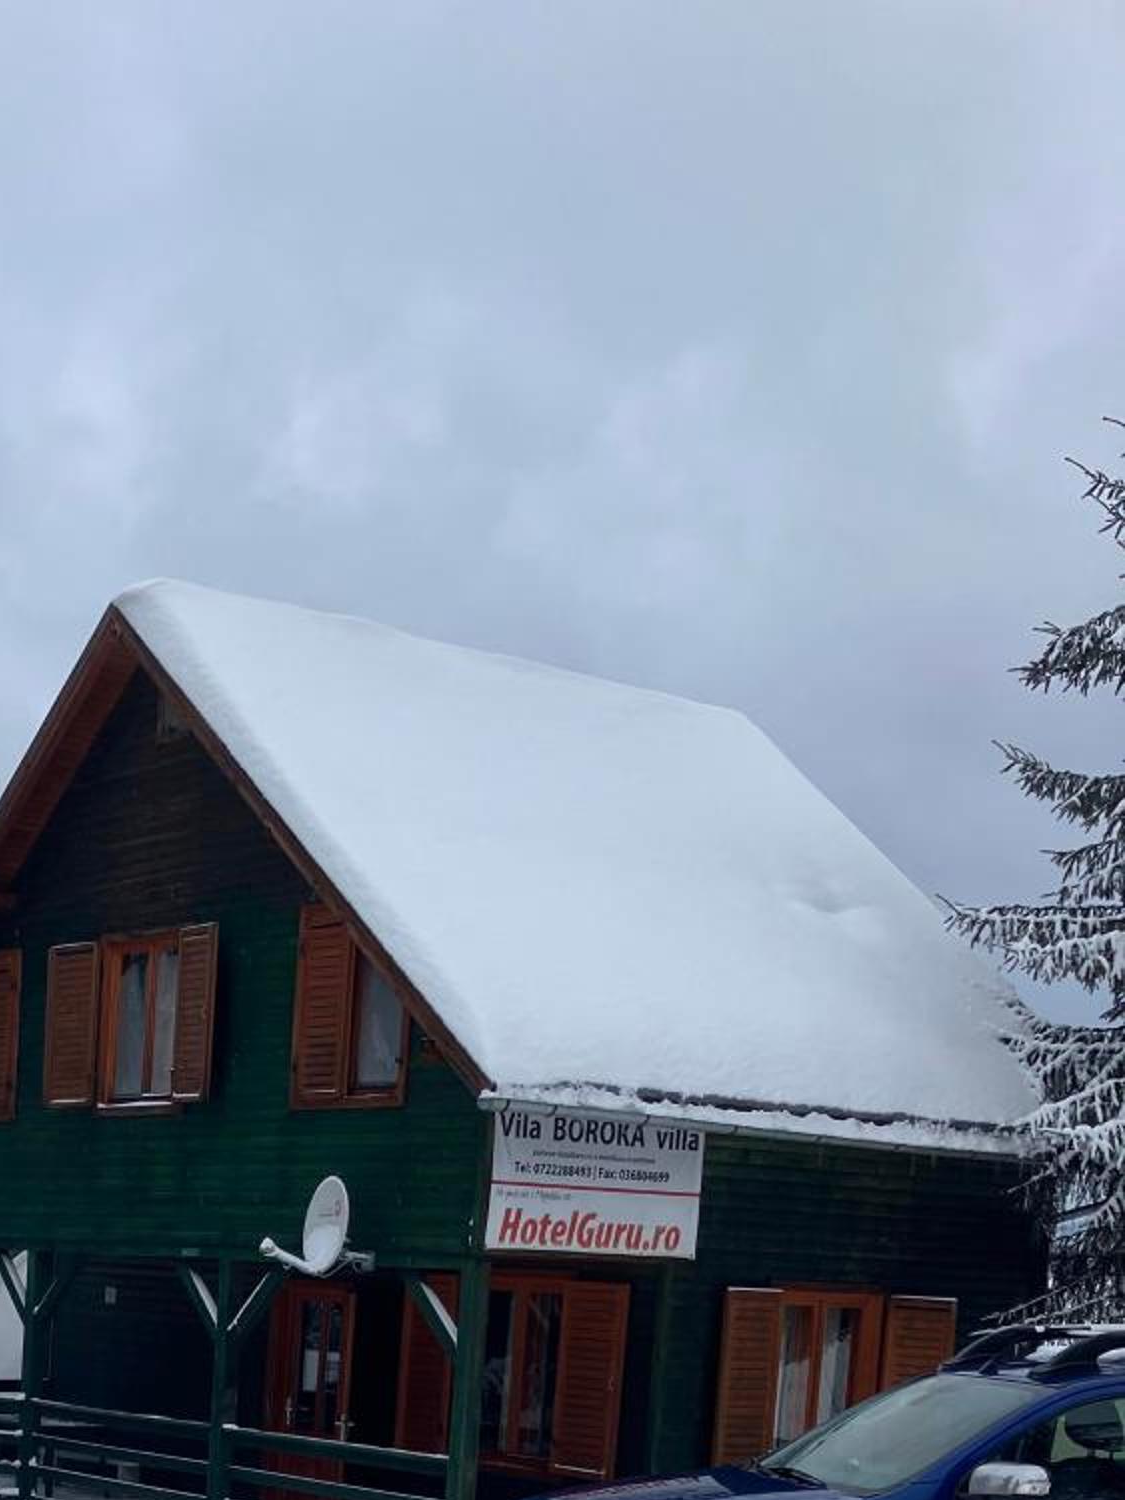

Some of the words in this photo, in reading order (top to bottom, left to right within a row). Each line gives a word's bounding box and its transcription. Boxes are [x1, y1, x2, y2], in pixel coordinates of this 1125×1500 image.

[500, 1112, 541, 1140] Vila
[553, 1117, 646, 1148] BOROKA
[514, 1161, 532, 1174] Tel:
[598, 1167, 617, 1180] Fax:
[498, 1207, 682, 1251] HotelGuru.ro
